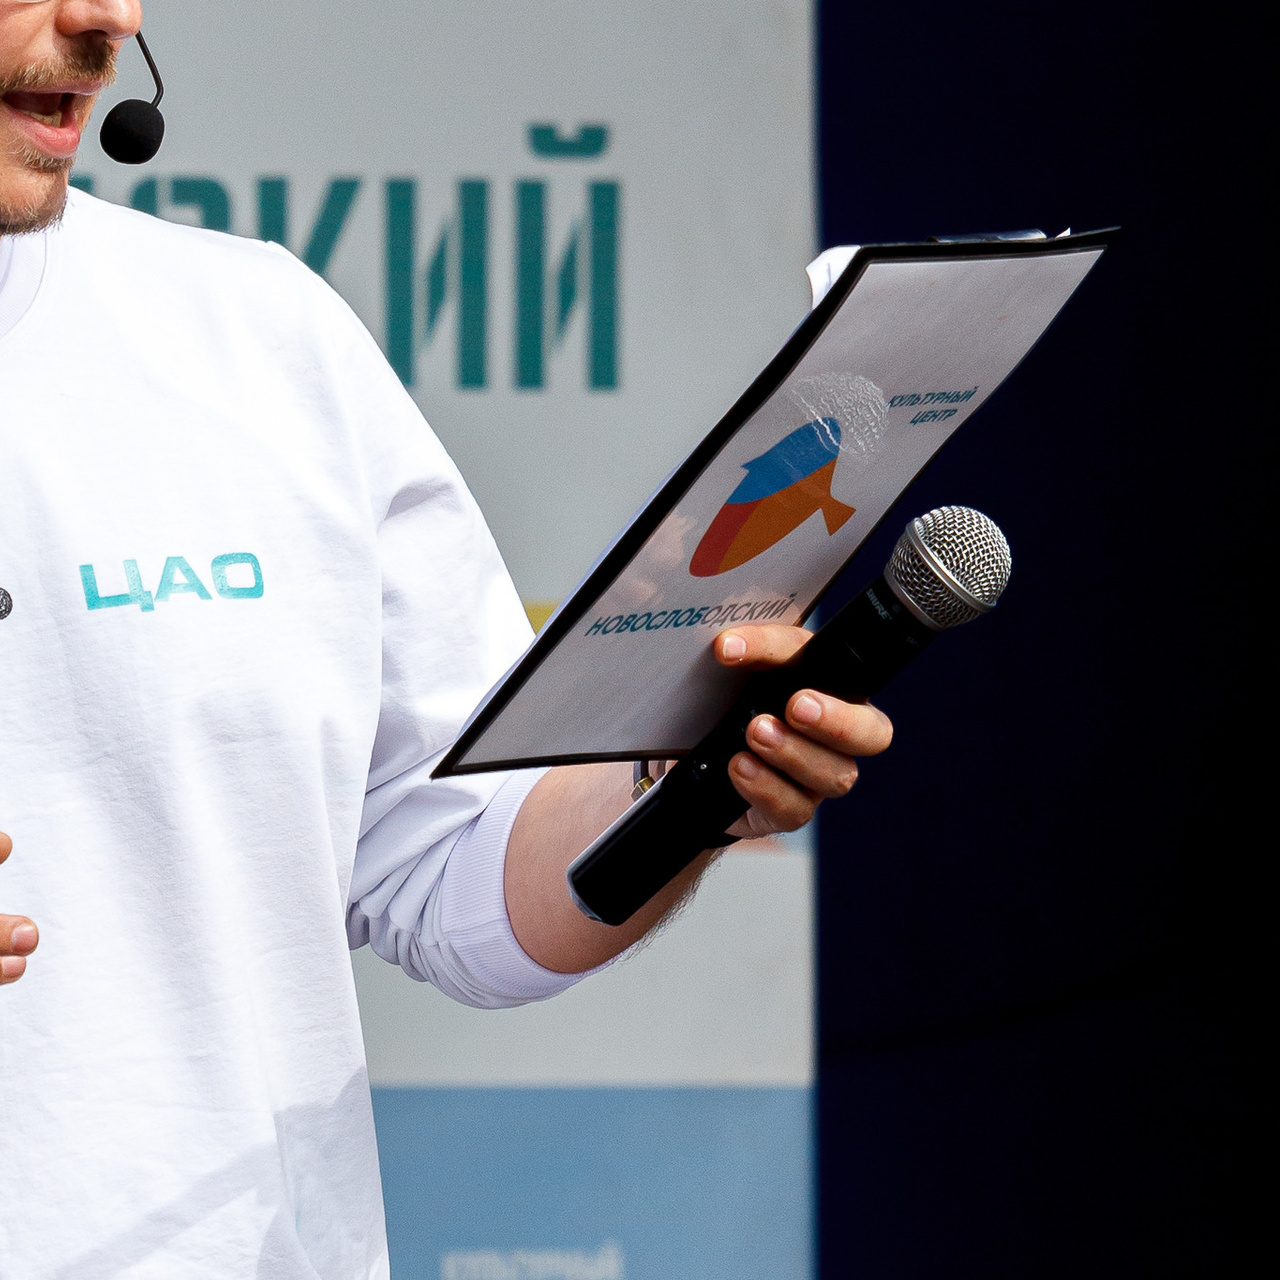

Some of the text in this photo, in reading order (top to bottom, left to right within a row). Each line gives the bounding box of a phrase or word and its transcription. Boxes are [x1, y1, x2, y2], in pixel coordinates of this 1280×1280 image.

[887, 386, 979, 409] КУЛЬТУРНЫЙ
[909, 408, 958, 426] ЦЕНТР
[79, 552, 264, 612] ЦАО
[584, 593, 797, 637] НОВОСЛОБОДСКИЙ
